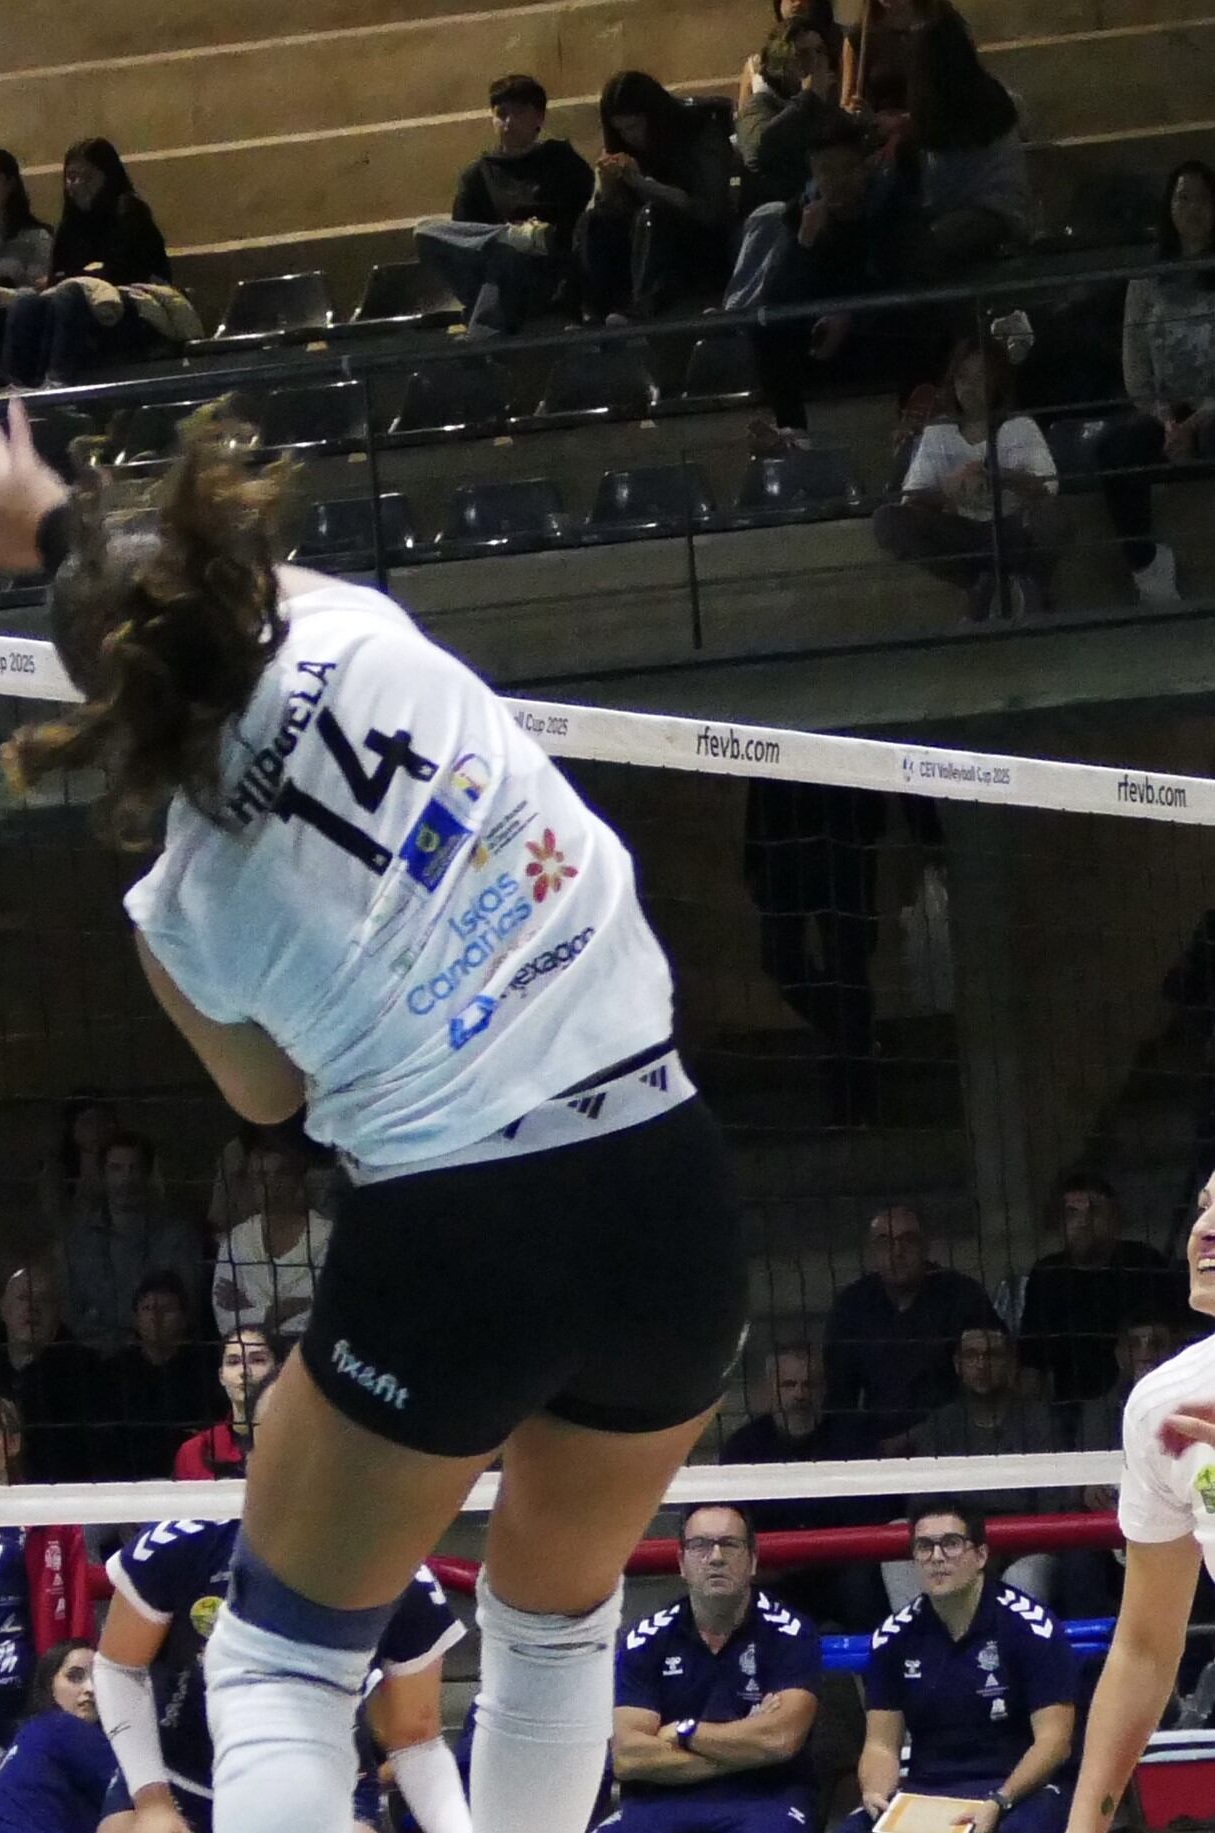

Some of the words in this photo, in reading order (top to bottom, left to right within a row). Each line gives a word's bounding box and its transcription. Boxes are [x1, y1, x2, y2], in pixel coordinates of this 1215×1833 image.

[8, 653, 36, 674] 2025
[526, 713, 546, 736] Cup
[546, 716, 569, 736] 2025
[696, 725, 780, 764] rfevb.com
[919, 761, 936, 778] CEV
[271, 705, 439, 877] 14
[1117, 774, 1186, 808] rfevb.com
